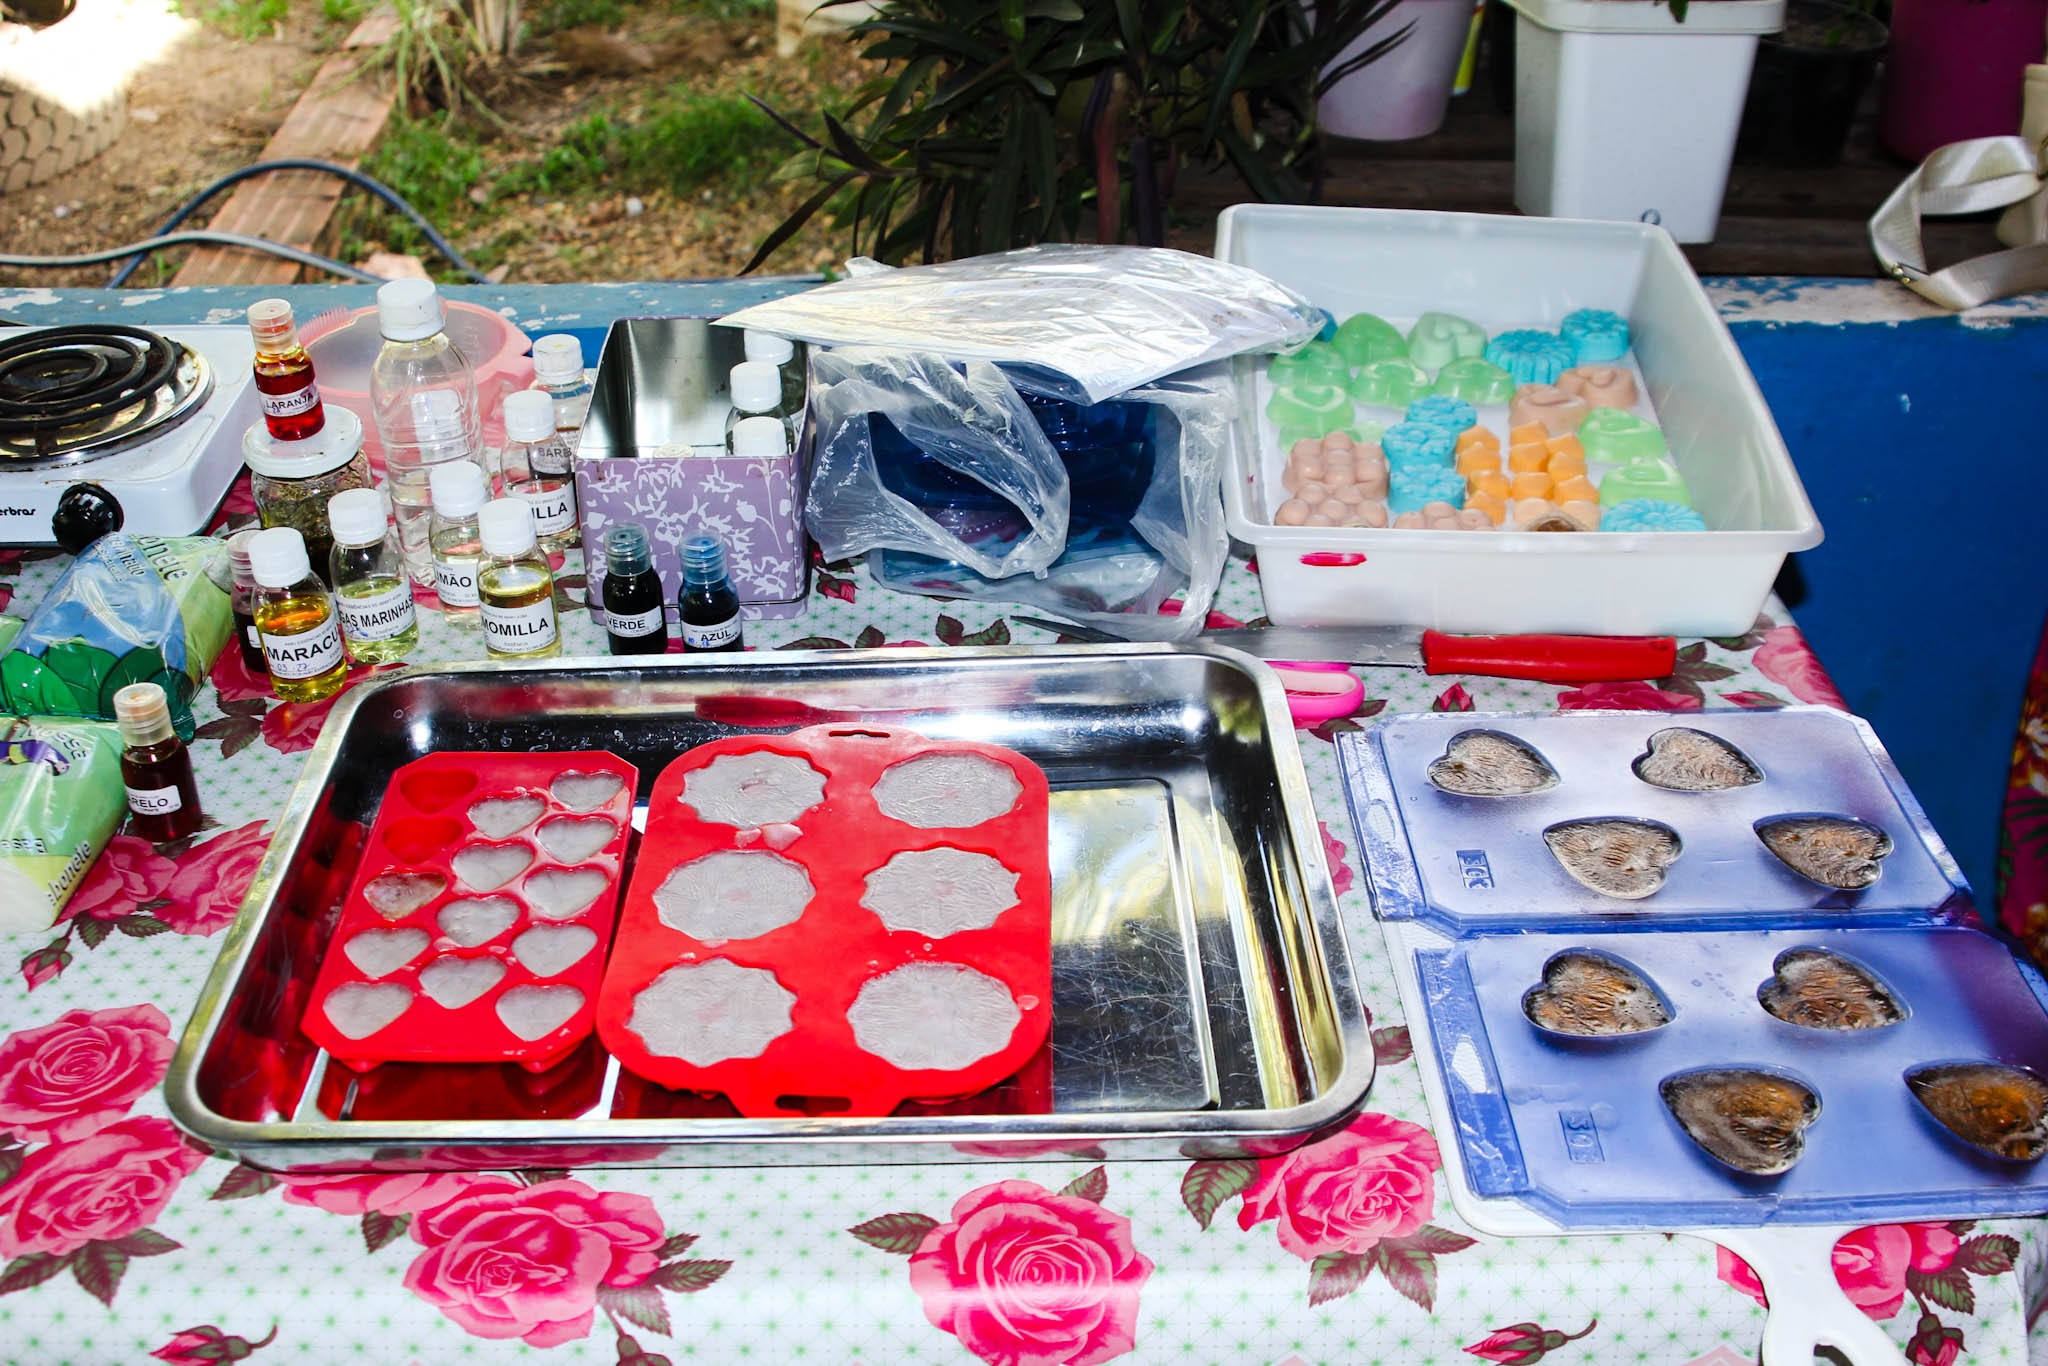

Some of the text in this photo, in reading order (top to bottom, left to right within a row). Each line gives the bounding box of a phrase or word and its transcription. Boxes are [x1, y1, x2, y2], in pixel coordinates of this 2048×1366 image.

[265, 391, 315, 410] LARANJA
[359, 593, 413, 628] MARINHAS
[606, 615, 646, 630] VERDE
[701, 629, 732, 642] AZUL
